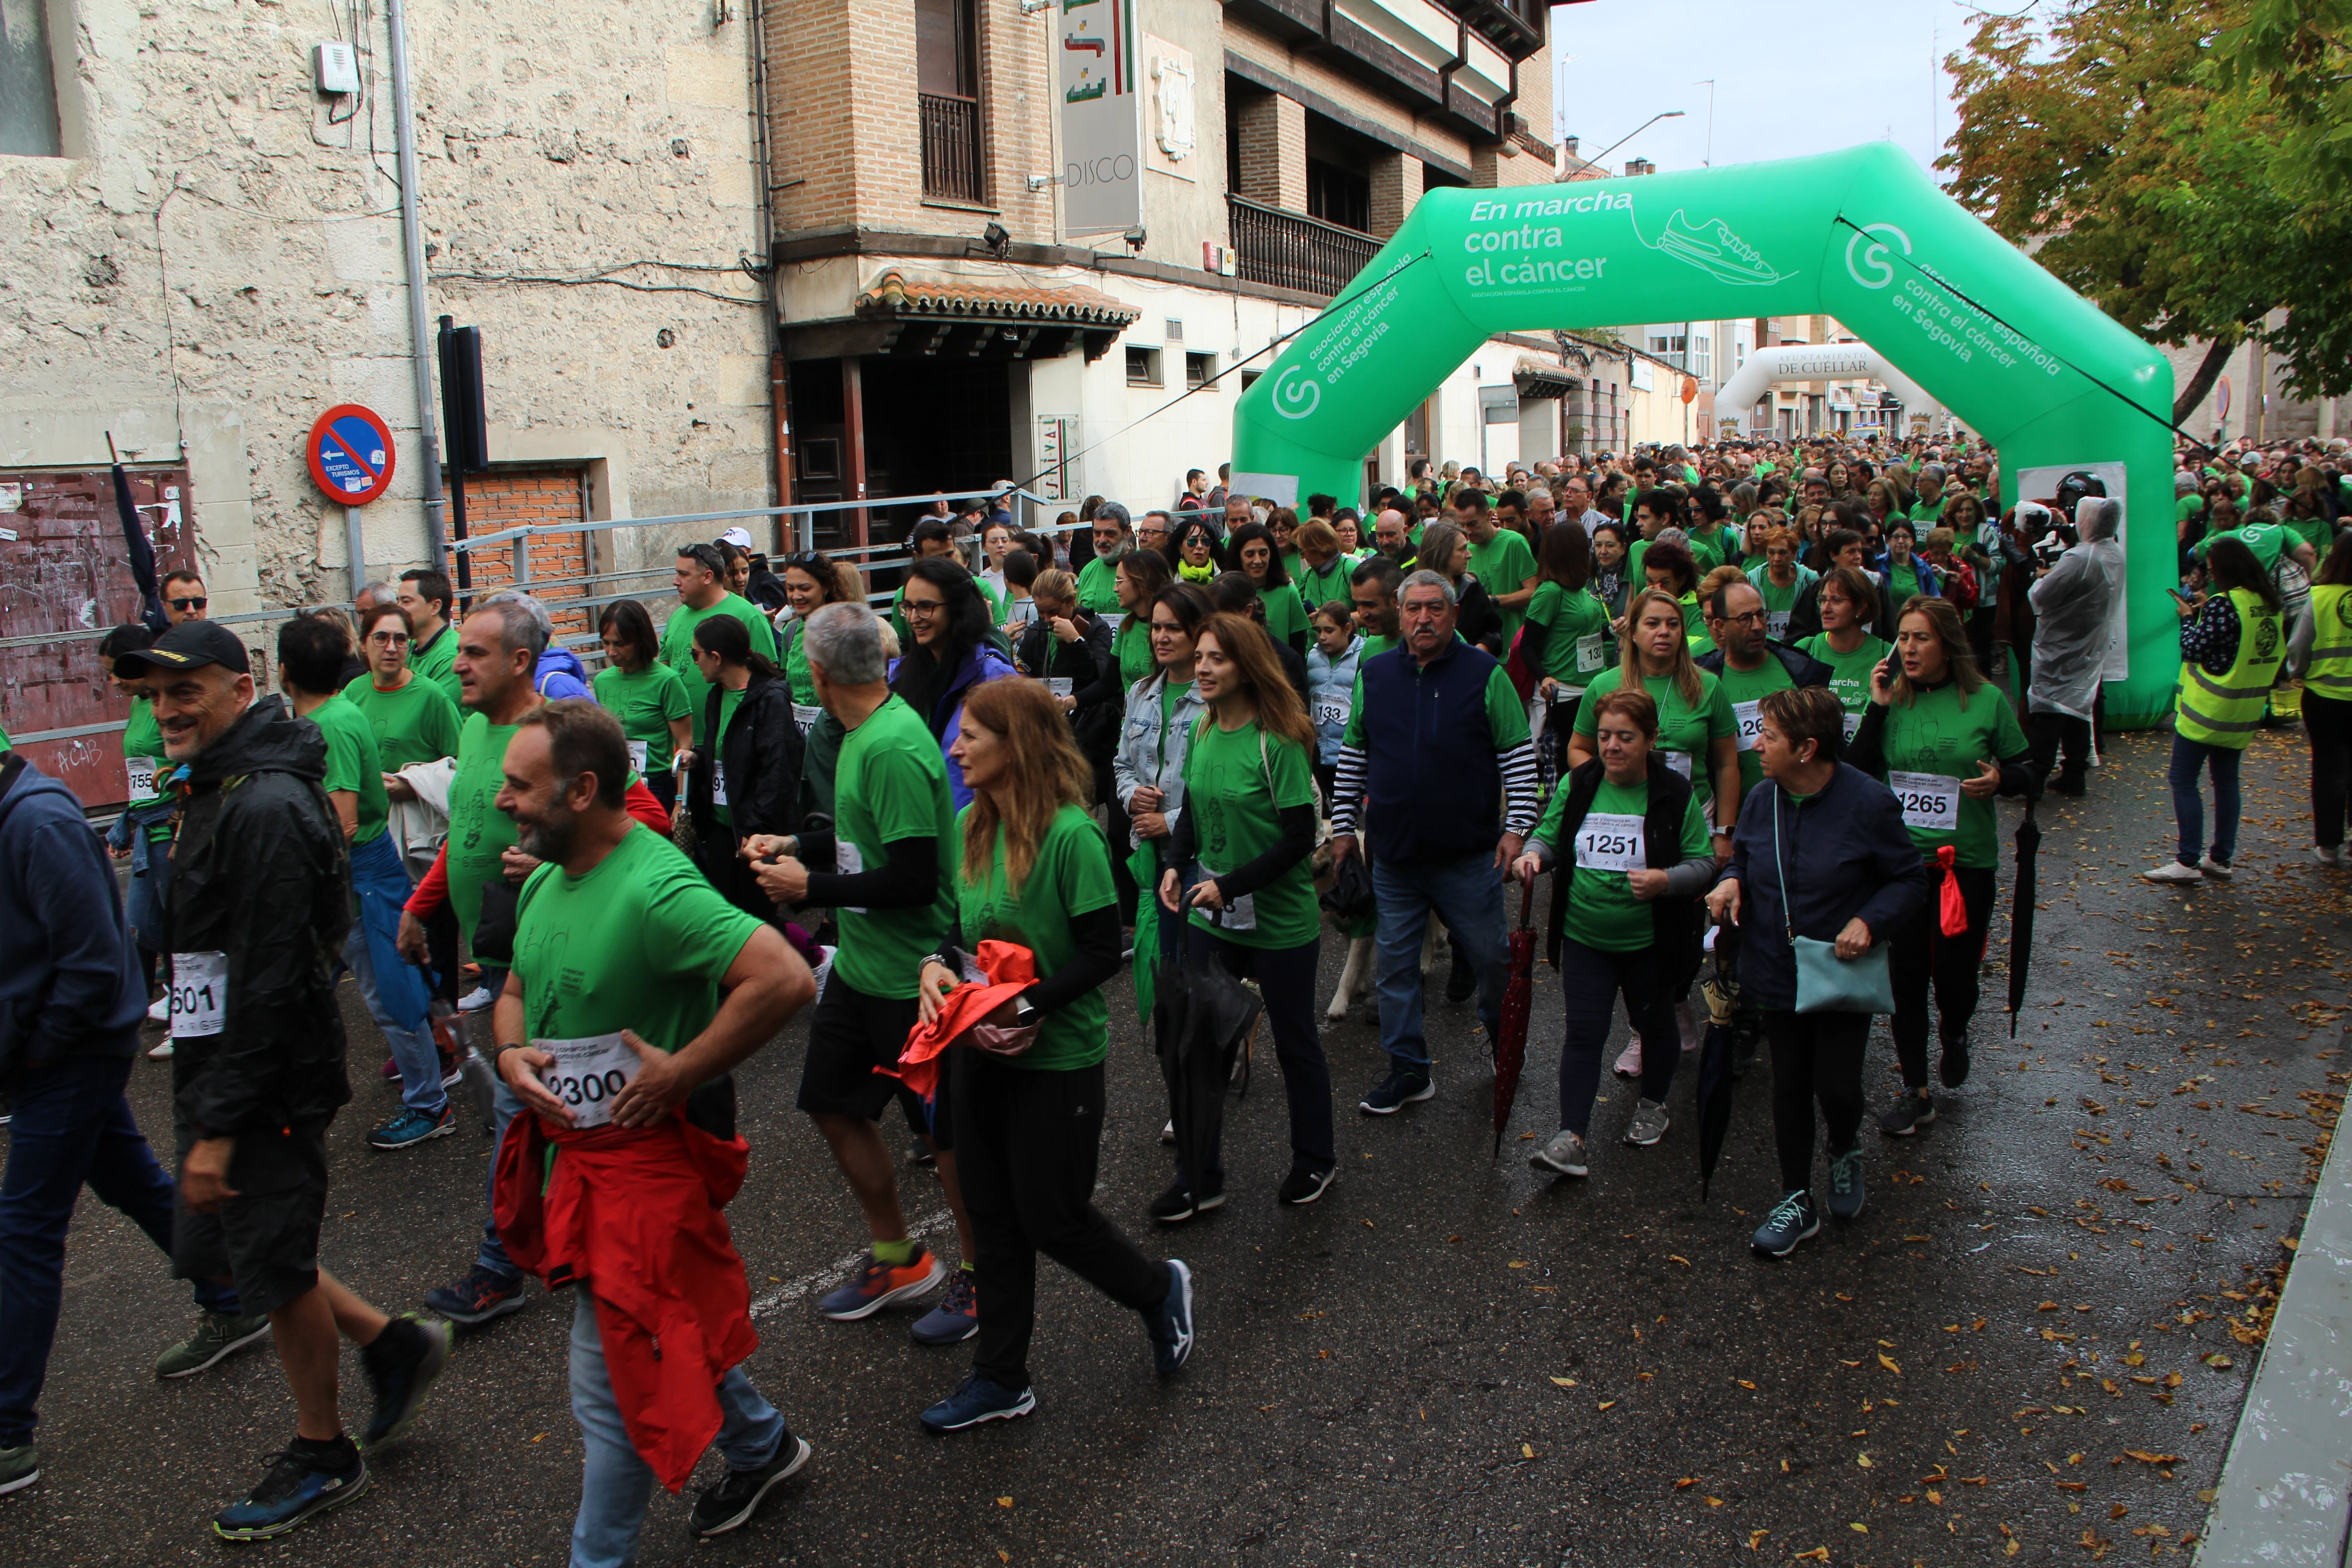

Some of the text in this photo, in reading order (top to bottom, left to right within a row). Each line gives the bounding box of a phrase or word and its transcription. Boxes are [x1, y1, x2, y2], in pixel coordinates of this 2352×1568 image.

[1067, 154, 1134, 188] DISCO
[1470, 190, 1633, 222] En marcha
[1464, 223, 1562, 253] contra
[1465, 255, 1607, 287] el cáncer
[1309, 253, 1412, 360] asociación española
[1317, 286, 1399, 373] contra el cáncer
[1892, 294, 1973, 363] en Segovia
[1905, 279, 2018, 369] contra el cáncer
[1327, 321, 1390, 385] en Segovia
[1779, 352, 1867, 362] AYUNTAMIENTO
[1993, 320, 2061, 376] española
[1779, 360, 1868, 374] DE CUÉLLAR
[331, 469, 360, 478] TURISMOS
[1319, 705, 1341, 719] 133
[57, 739, 103, 774] ACAB
[1899, 792, 1947, 814] 1265
[1586, 834, 1637, 856] 1251
